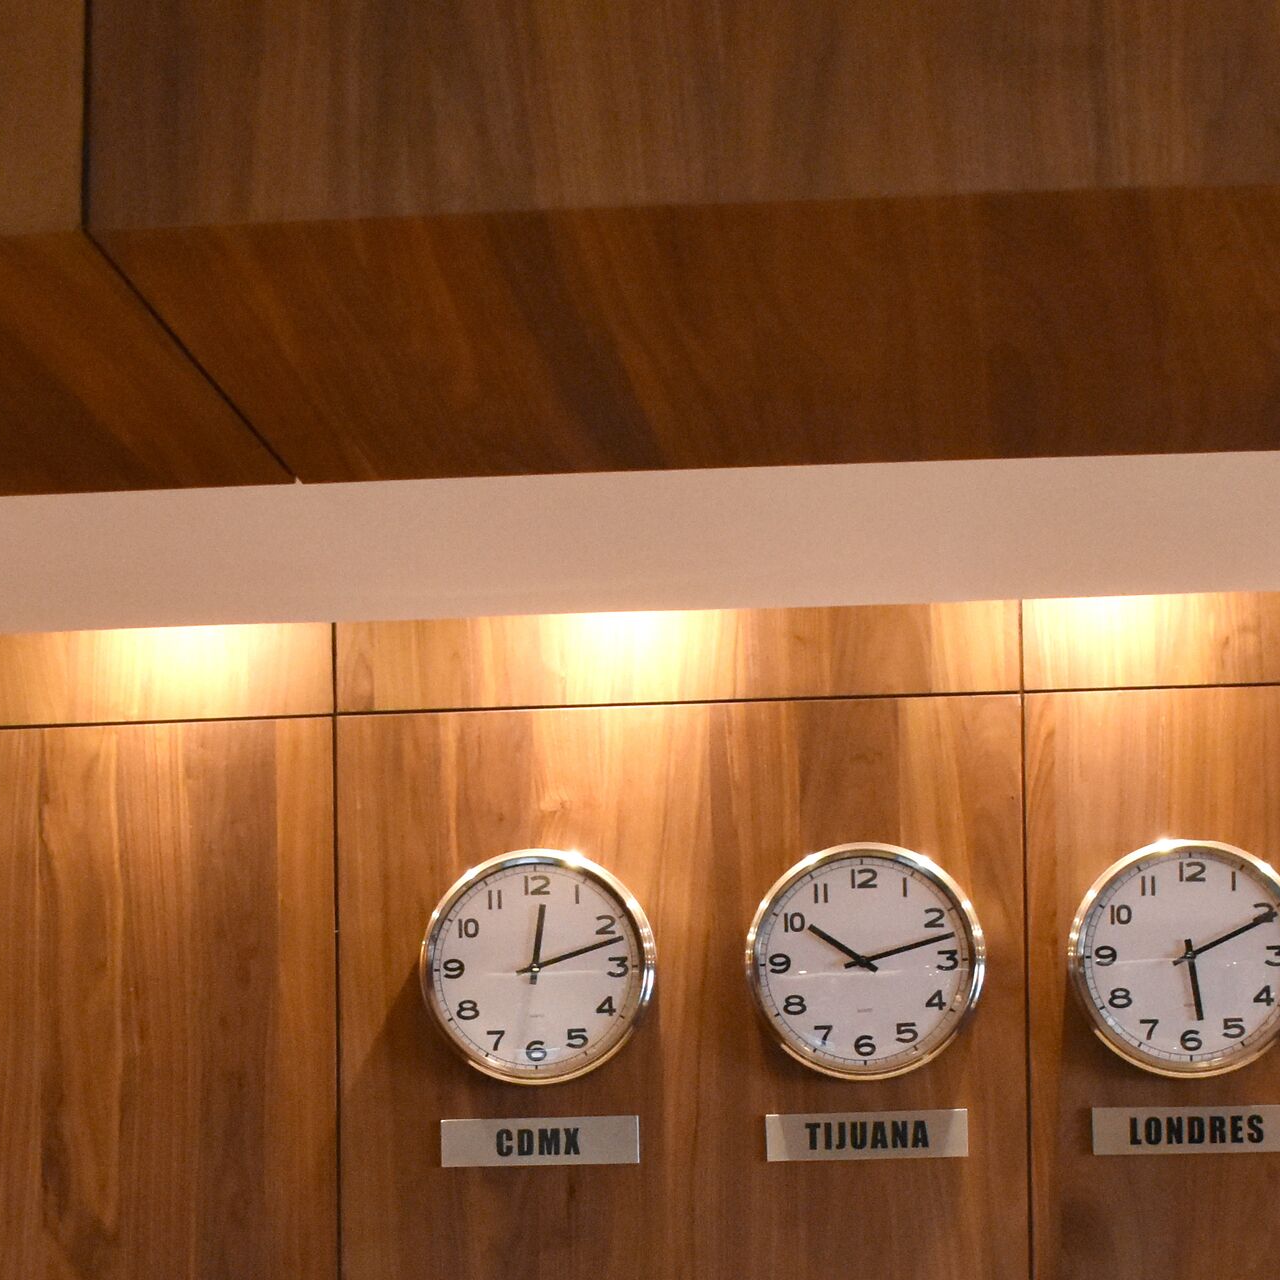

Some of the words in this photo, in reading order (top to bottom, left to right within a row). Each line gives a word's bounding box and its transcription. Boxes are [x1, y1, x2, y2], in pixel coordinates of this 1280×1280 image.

[850, 868, 878, 889] 12
[1178, 861, 1206, 883] 12
[1231, 871, 1237, 892] 1
[524, 875, 551, 896] 12
[574, 884, 580, 905] 1
[813, 883, 829, 904] 11
[902, 877, 908, 898] 1
[1140, 875, 1156, 897] 11
[487, 889, 503, 911] 11
[595, 914, 616, 936] 2
[783, 912, 806, 933] 10
[923, 907, 945, 929] 2
[1110, 904, 1133, 926] 10
[457, 918, 480, 939] 10
[606, 955, 630, 978] 3
[768, 953, 792, 975] 9
[936, 949, 959, 972] 3
[1094, 945, 1118, 967] 9
[442, 958, 465, 980] 9
[595, 995, 617, 1017] 4
[782, 994, 807, 1016] 8
[925, 989, 947, 1011] 4
[1108, 987, 1133, 1009] 8
[1252, 984, 1275, 1007] 4
[456, 999, 480, 1021] 8
[565, 1027, 589, 1049] 5
[813, 1024, 833, 1046] 7
[895, 1022, 919, 1044] 5
[1139, 1018, 1159, 1041] 7
[1222, 1017, 1246, 1039] 5
[486, 1029, 506, 1052] 7
[525, 1040, 547, 1062] 6
[853, 1034, 877, 1057] 6
[1180, 1029, 1203, 1052] 6
[804, 1119, 930, 1151] TIJUANA
[1128, 1113, 1265, 1146] LONDRES
[494, 1126, 581, 1157] CDMX
